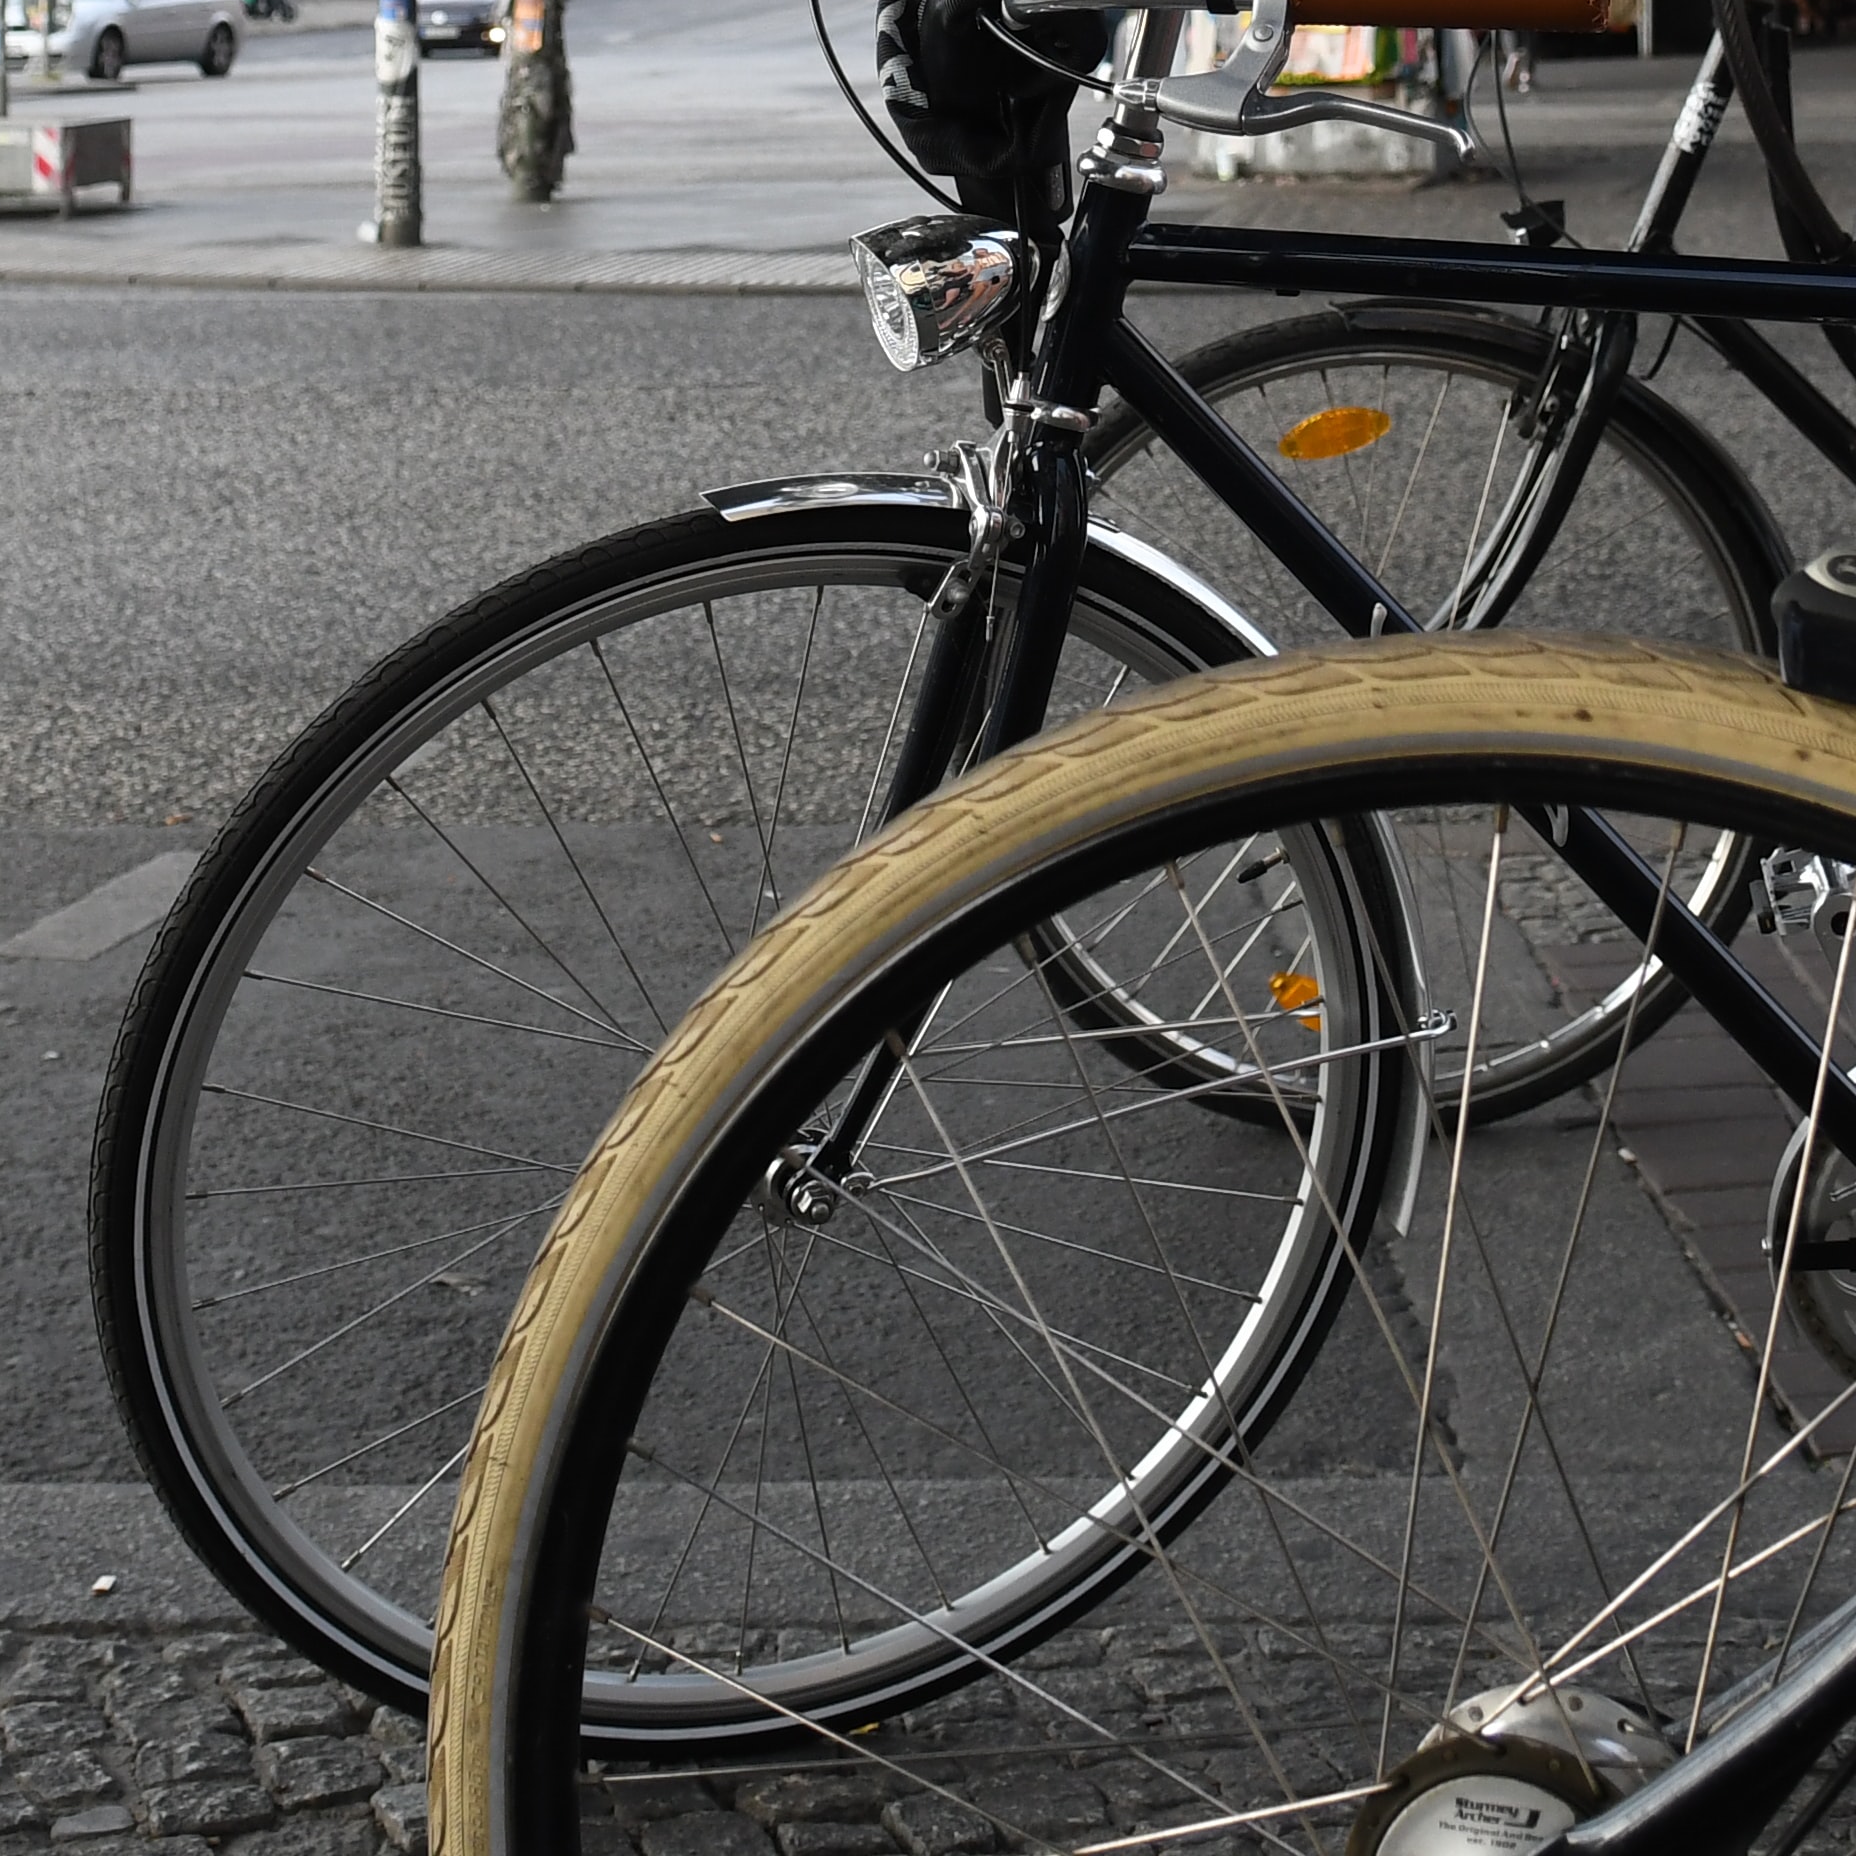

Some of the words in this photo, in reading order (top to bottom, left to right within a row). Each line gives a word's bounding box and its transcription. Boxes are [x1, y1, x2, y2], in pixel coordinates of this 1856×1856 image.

[1455, 1797, 1519, 1818] Sturmey
[1455, 1808, 1501, 1825] Archer
[1458, 1824, 1500, 1837] Original
